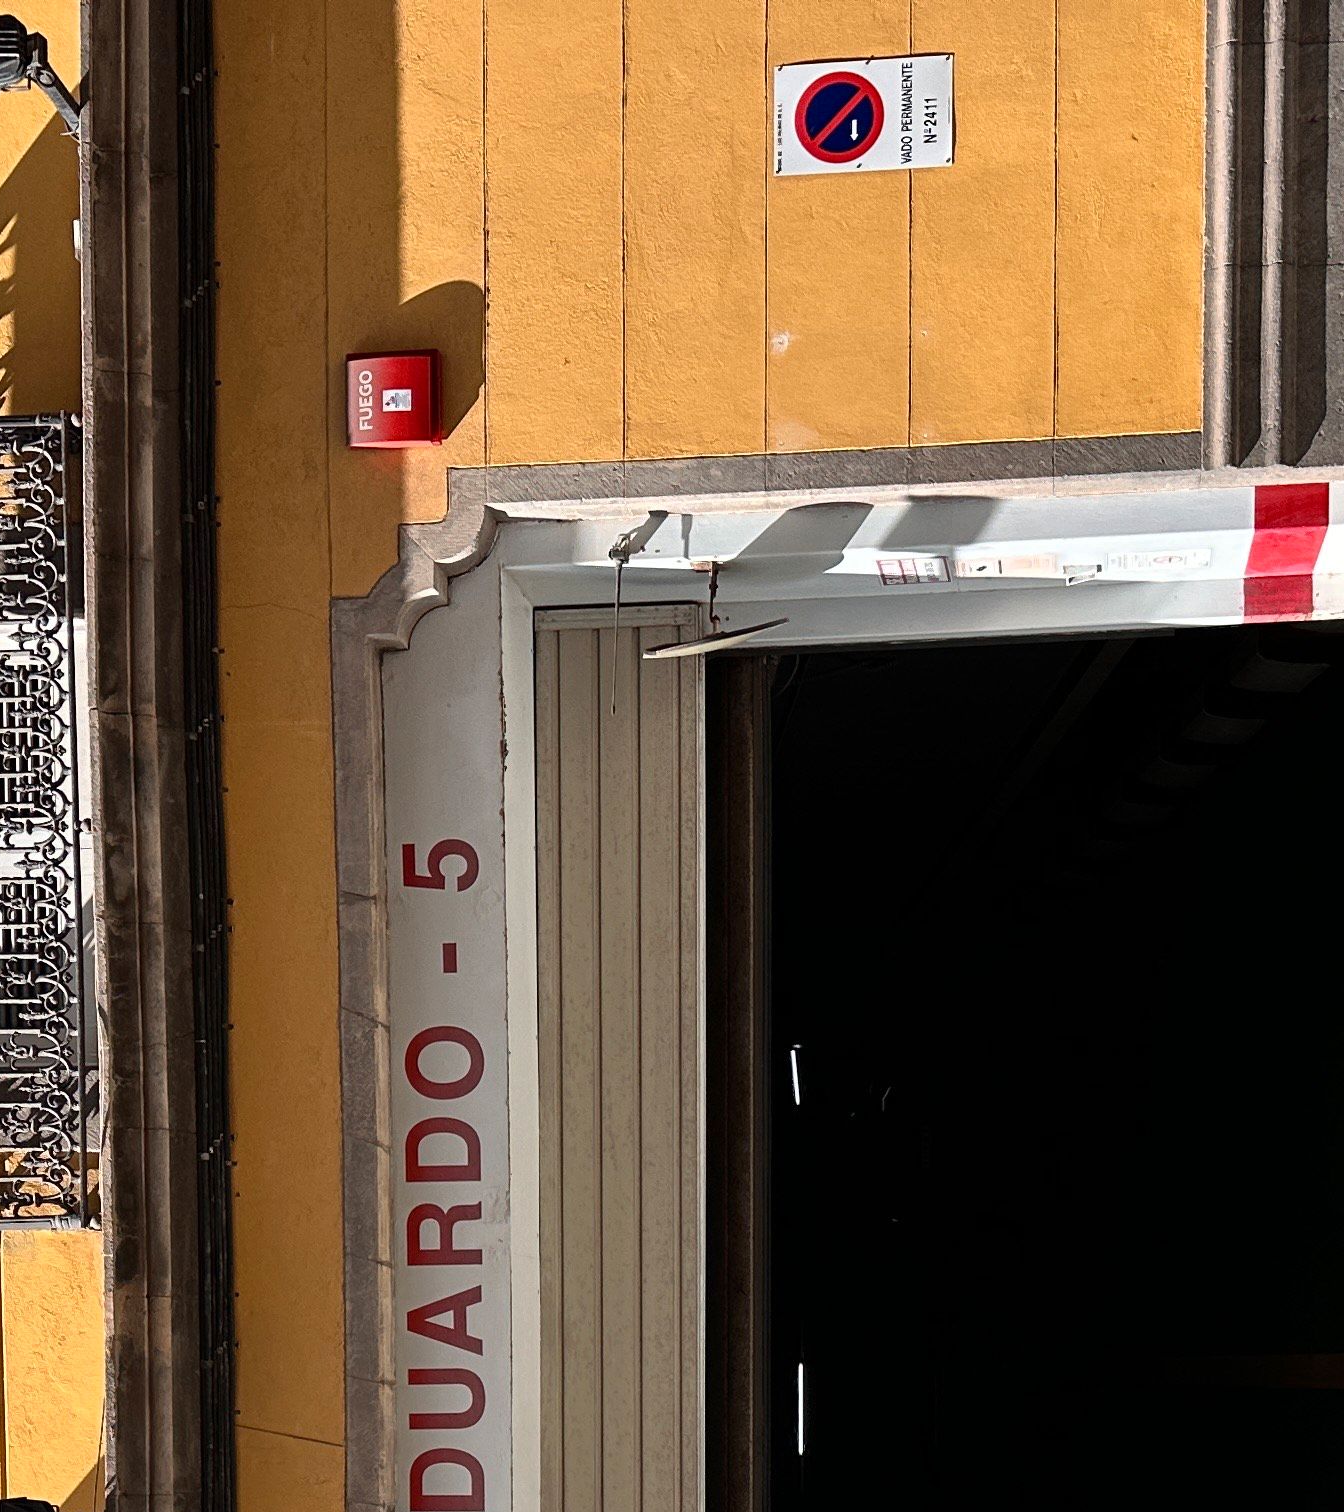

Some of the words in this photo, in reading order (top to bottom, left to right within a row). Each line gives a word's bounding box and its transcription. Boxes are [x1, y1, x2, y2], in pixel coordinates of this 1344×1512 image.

[900, 61, 913, 132] PERMANENTE
[900, 135, 913, 164] VADO
[358, 370, 373, 431] FUEGO
[401, 840, 477, 890] 5
